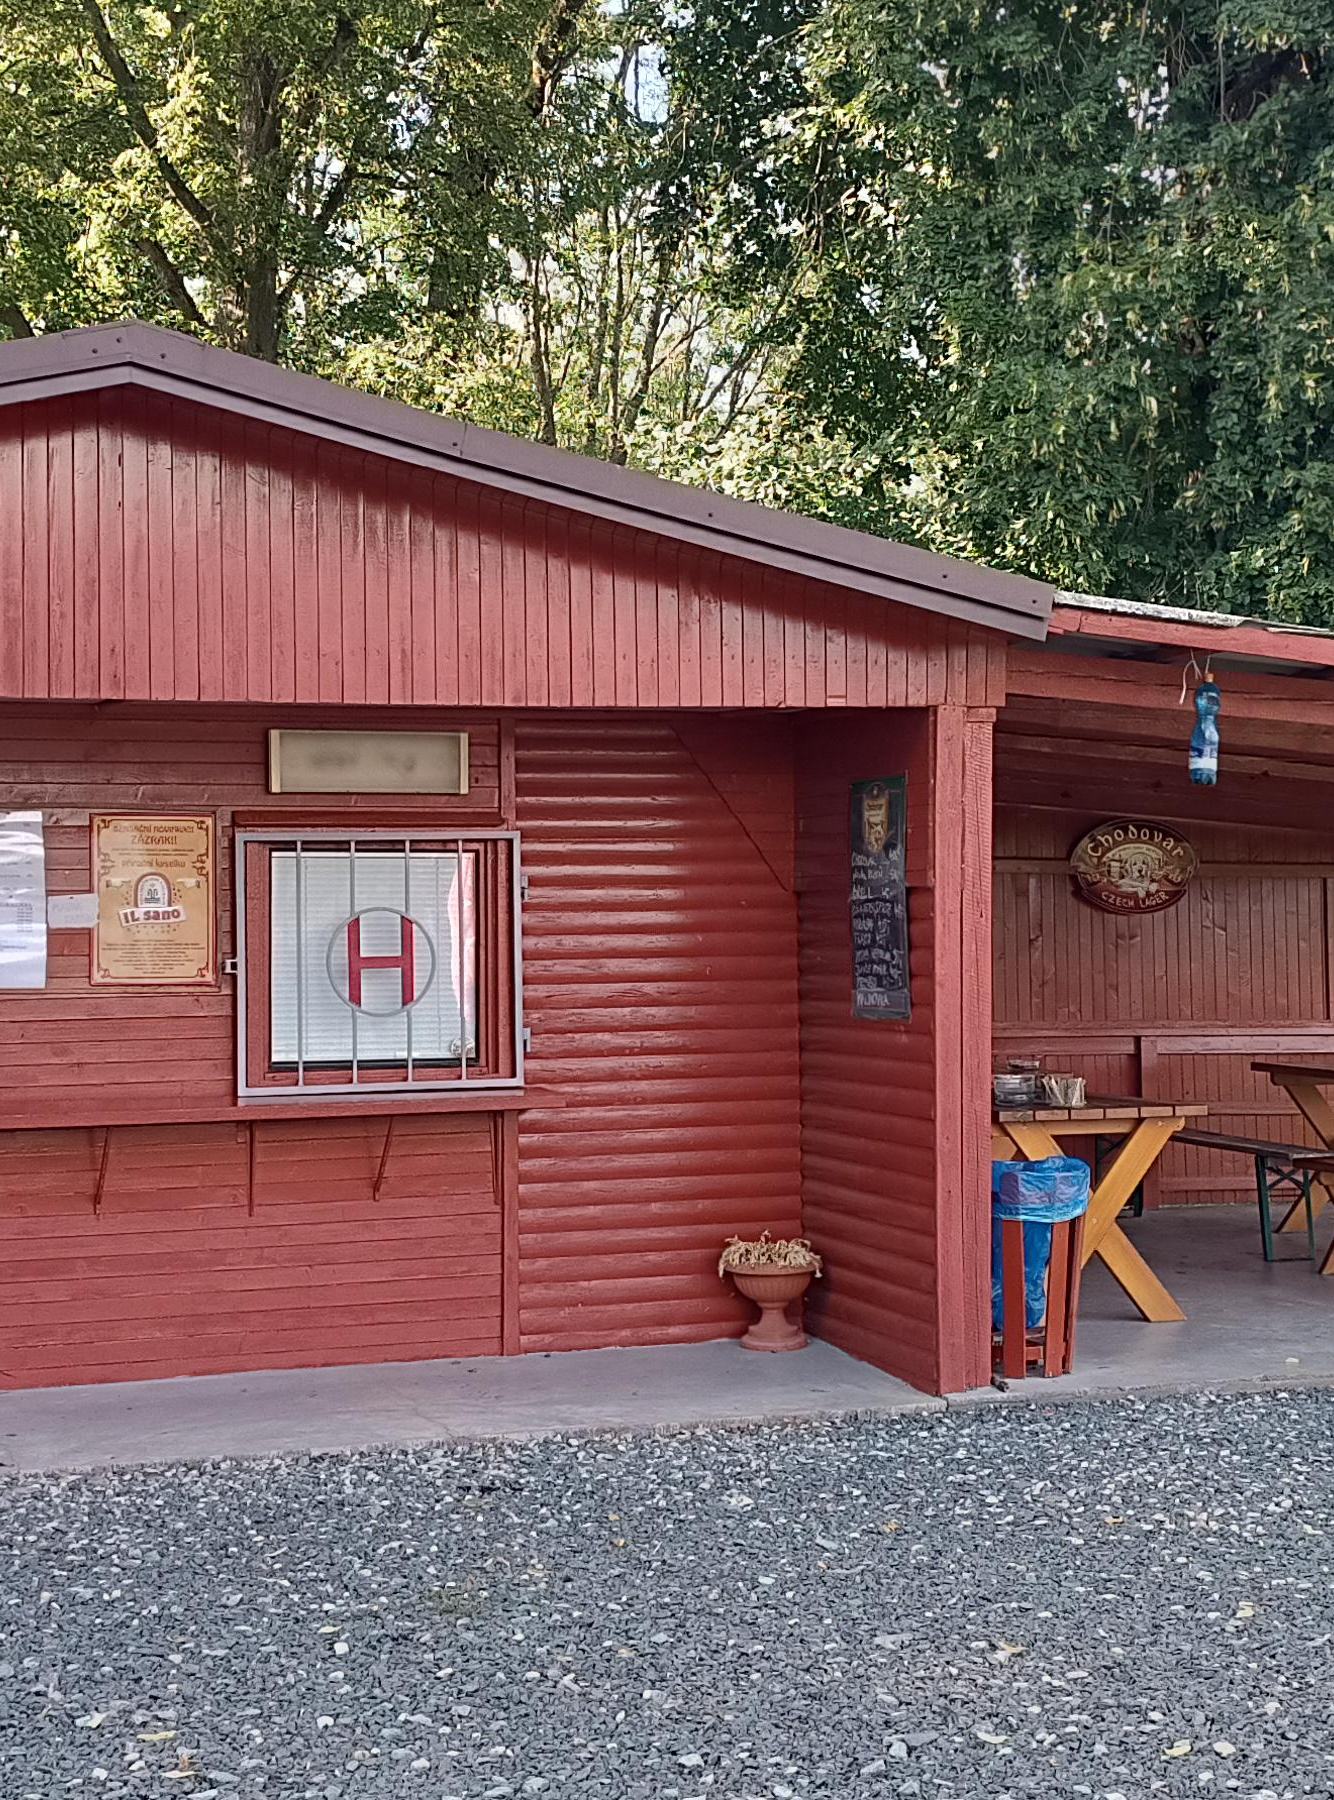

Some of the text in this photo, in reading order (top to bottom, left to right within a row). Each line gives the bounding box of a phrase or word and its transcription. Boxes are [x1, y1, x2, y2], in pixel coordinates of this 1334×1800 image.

[1087, 824, 1184, 857] Chodovar
[1101, 891, 1170, 908] CZECH LAGER
[143, 909, 181, 921] sano
[347, 915, 415, 1008] H
